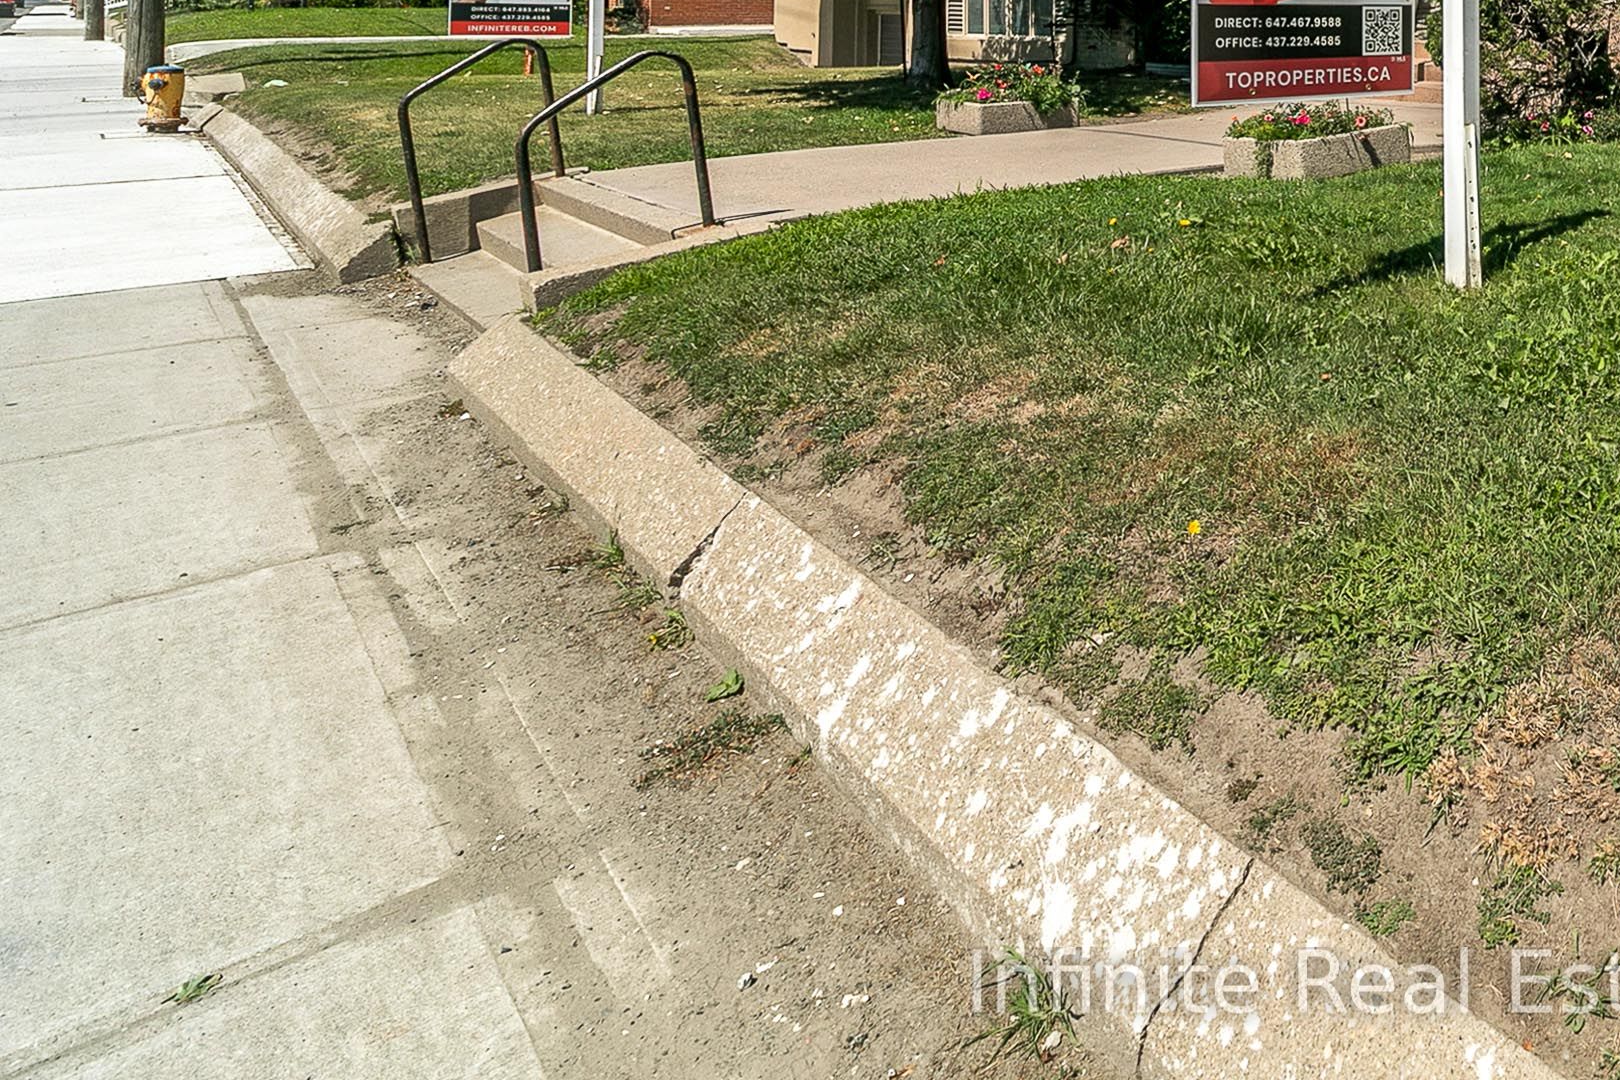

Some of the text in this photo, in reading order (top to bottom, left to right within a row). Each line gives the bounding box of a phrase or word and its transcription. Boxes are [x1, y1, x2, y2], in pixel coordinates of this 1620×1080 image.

[1215, 17, 1342, 29] DIRECT: 647.467.9588
[1215, 35, 1342, 49] OFFICE: 437.229.4585
[1225, 66, 1391, 89] TOPROPERTIES.CA
